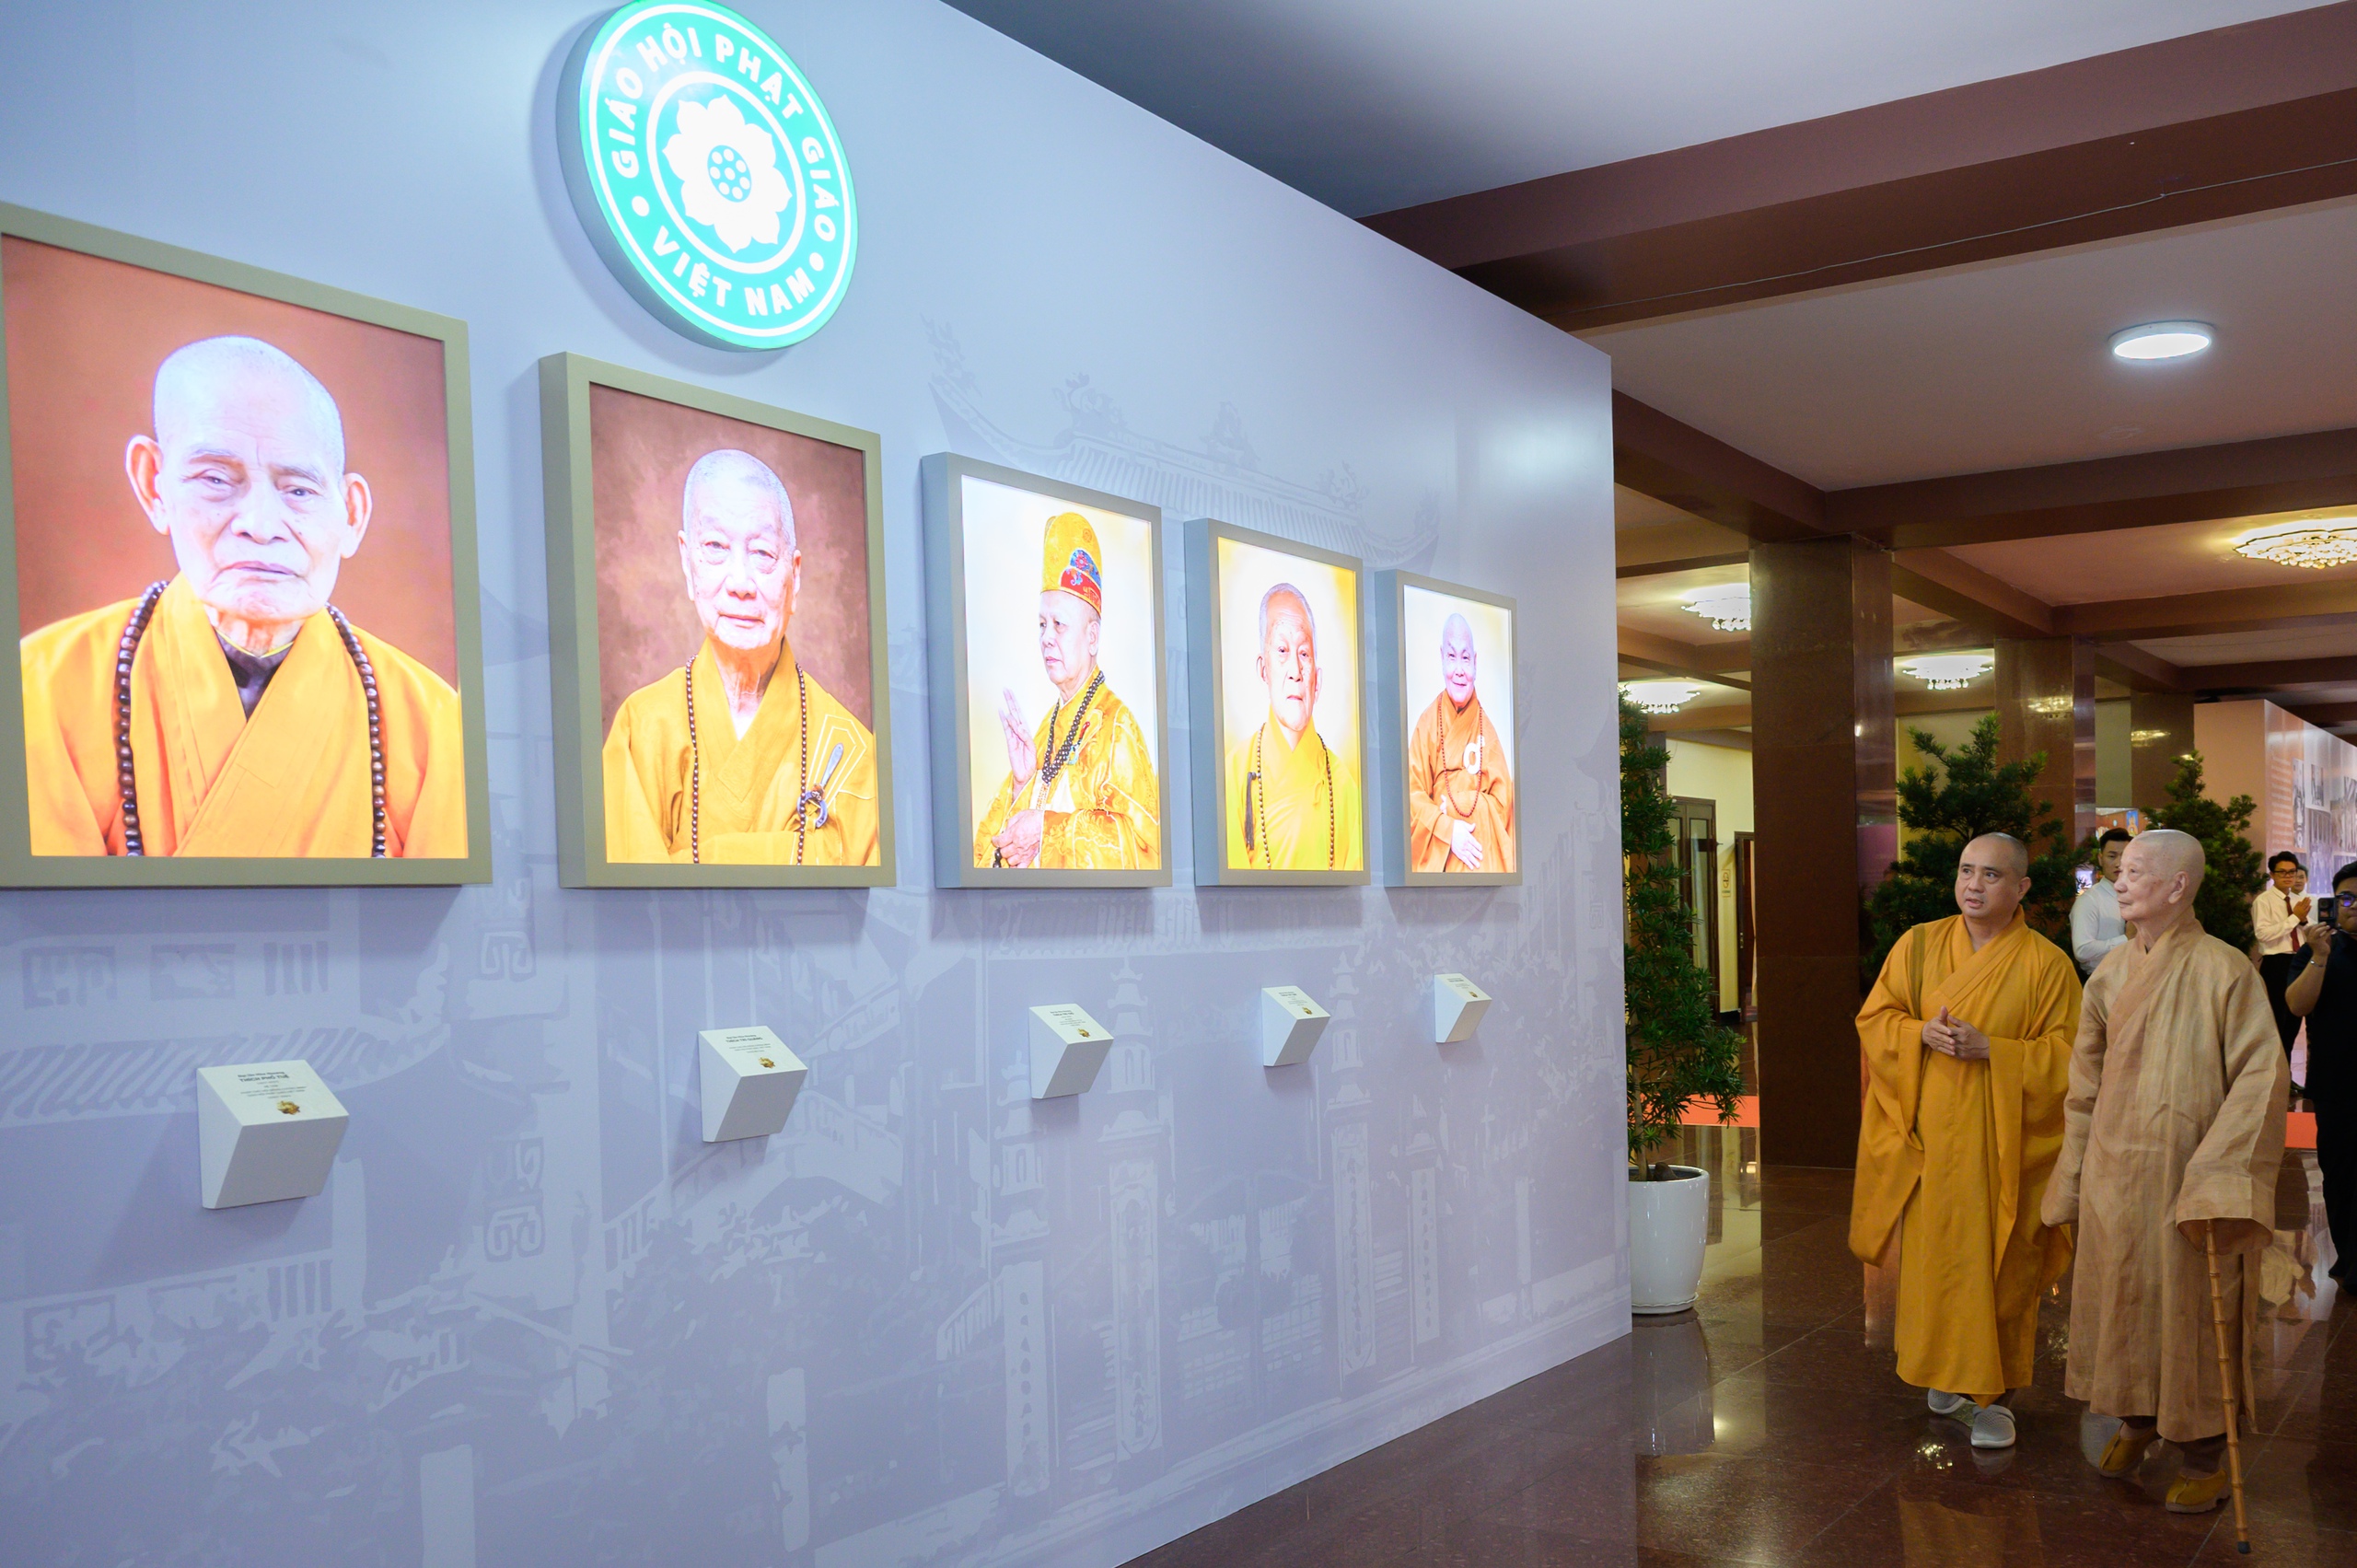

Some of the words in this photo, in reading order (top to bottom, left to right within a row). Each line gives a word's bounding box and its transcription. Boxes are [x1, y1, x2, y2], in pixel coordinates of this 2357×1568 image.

[604, 67, 644, 179] GIÁO
[636, 22, 702, 73] HỘI
[715, 33, 804, 120] PHẬT
[802, 136, 840, 242] GIÁO
[653, 226, 732, 308] VIỆT
[744, 267, 816, 317] NAM
